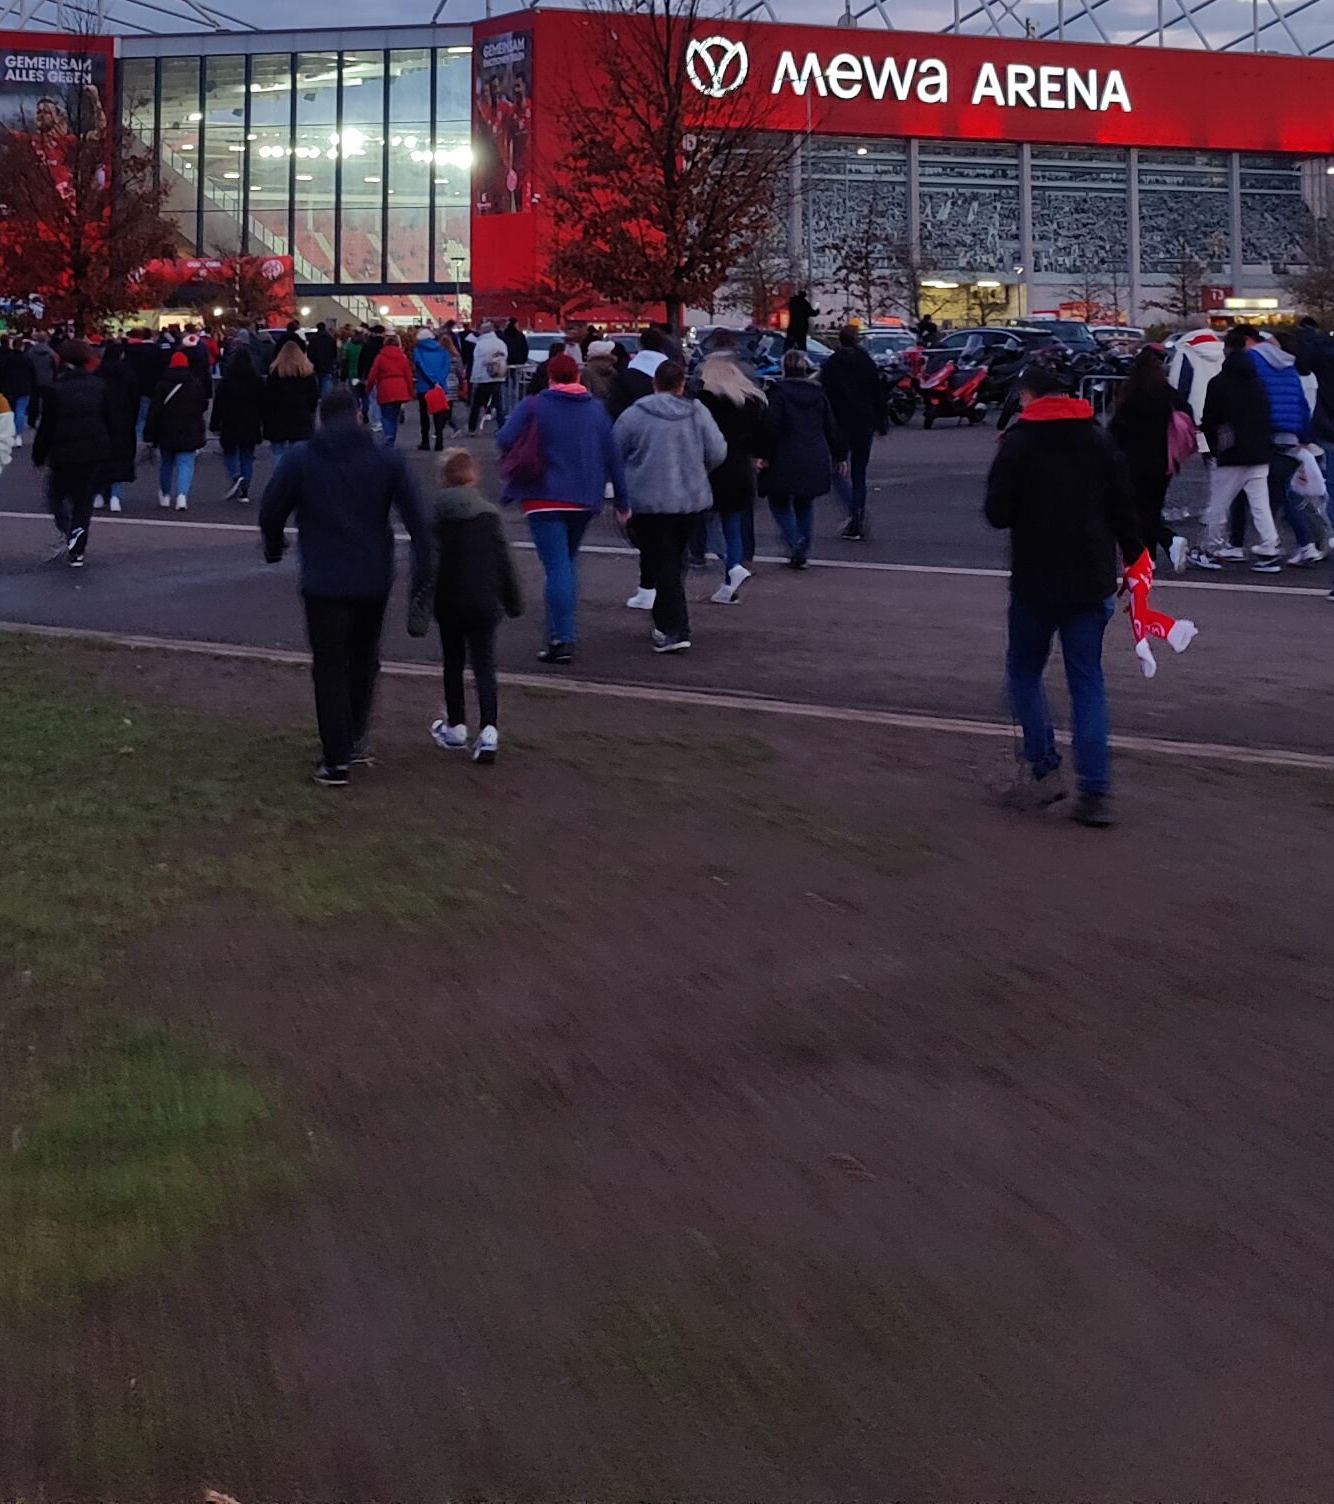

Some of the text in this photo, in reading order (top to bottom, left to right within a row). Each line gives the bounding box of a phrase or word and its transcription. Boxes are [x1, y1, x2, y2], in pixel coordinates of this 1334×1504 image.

[4, 55, 92, 71] GEMEINSAM
[4, 69, 92, 84] ALLES GEBEN
[971, 62, 1132, 113] ARENA
